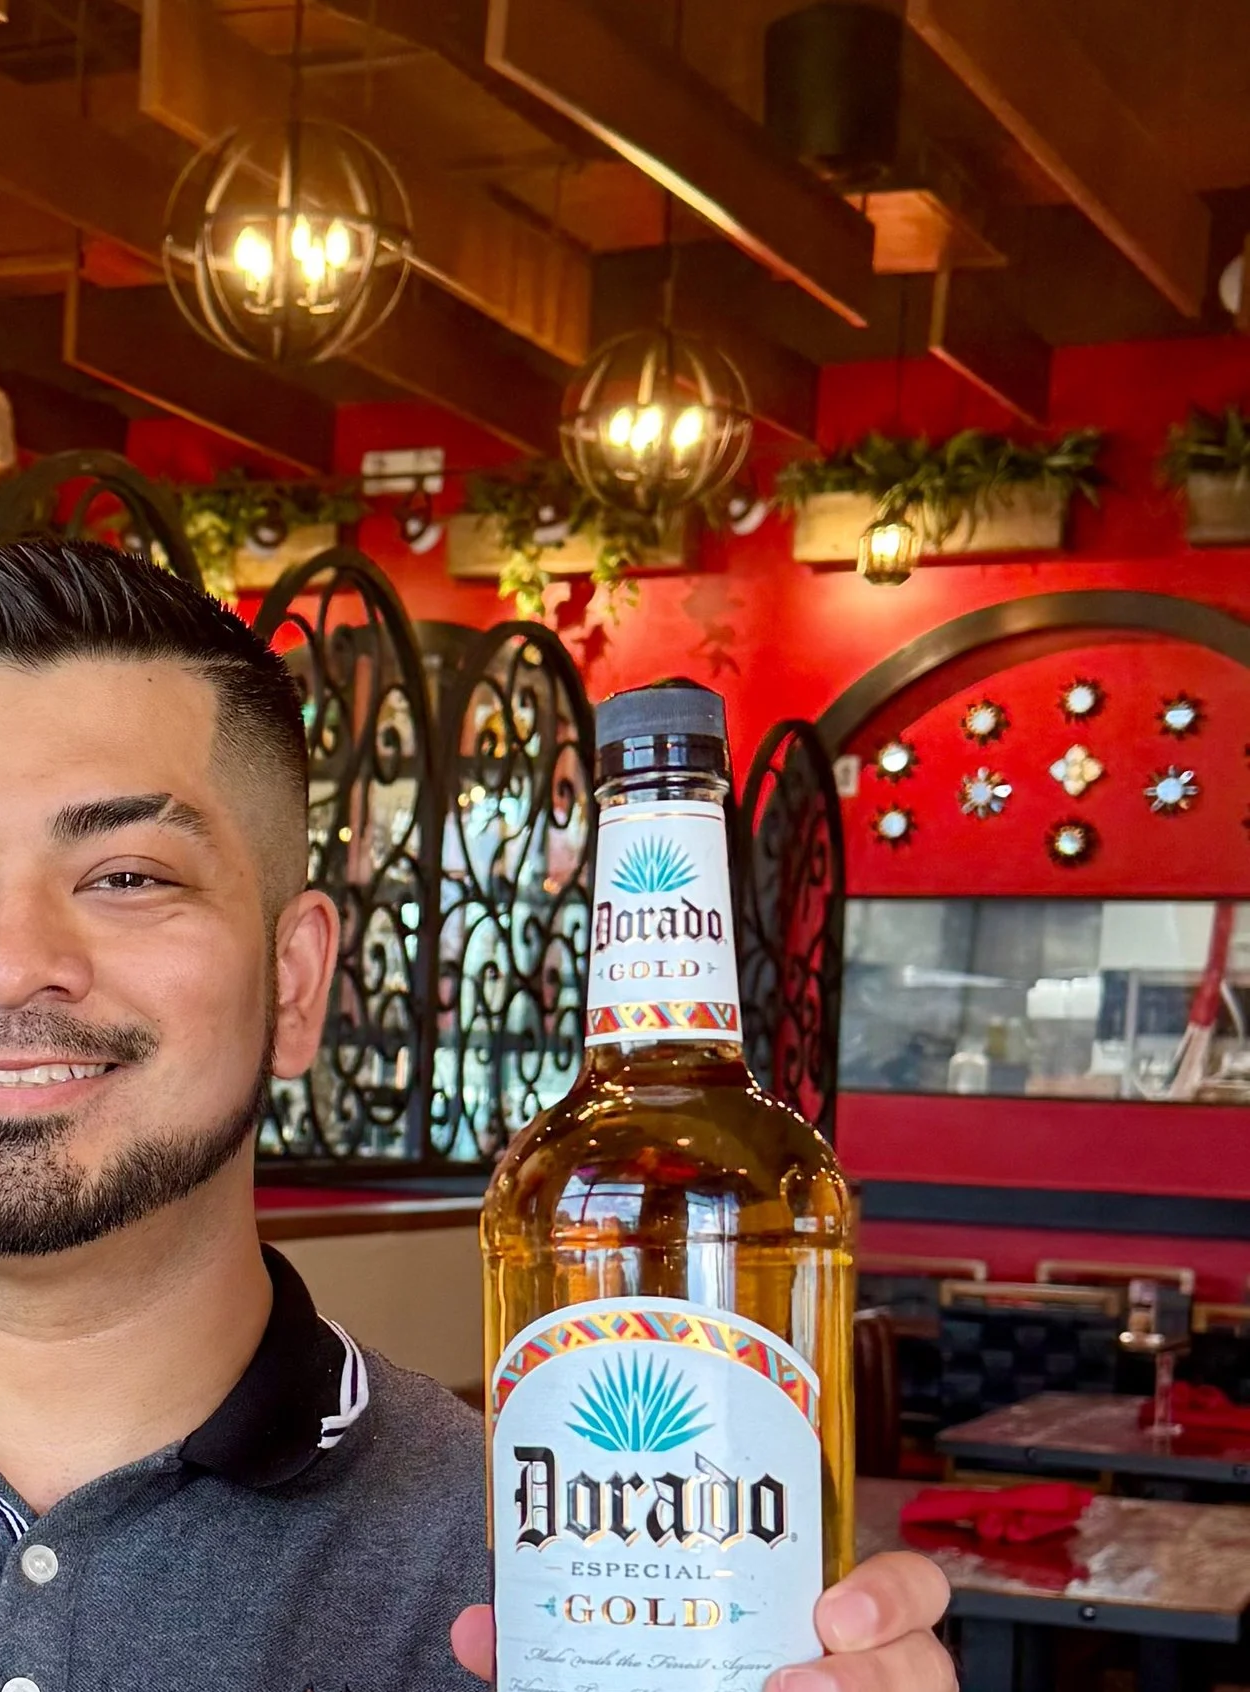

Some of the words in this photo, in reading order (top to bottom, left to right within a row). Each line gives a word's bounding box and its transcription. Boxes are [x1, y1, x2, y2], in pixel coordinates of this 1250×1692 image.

[594, 896, 723, 954] Dorado
[608, 959, 700, 982] GOLD
[513, 1445, 790, 1553] Dorado
[571, 1561, 712, 1580] ESPECIAL
[563, 1593, 724, 1630] GOLD
[616, 1652, 642, 1668] the
[646, 1653, 712, 1670] Finest
[712, 1655, 772, 1681] Agave
